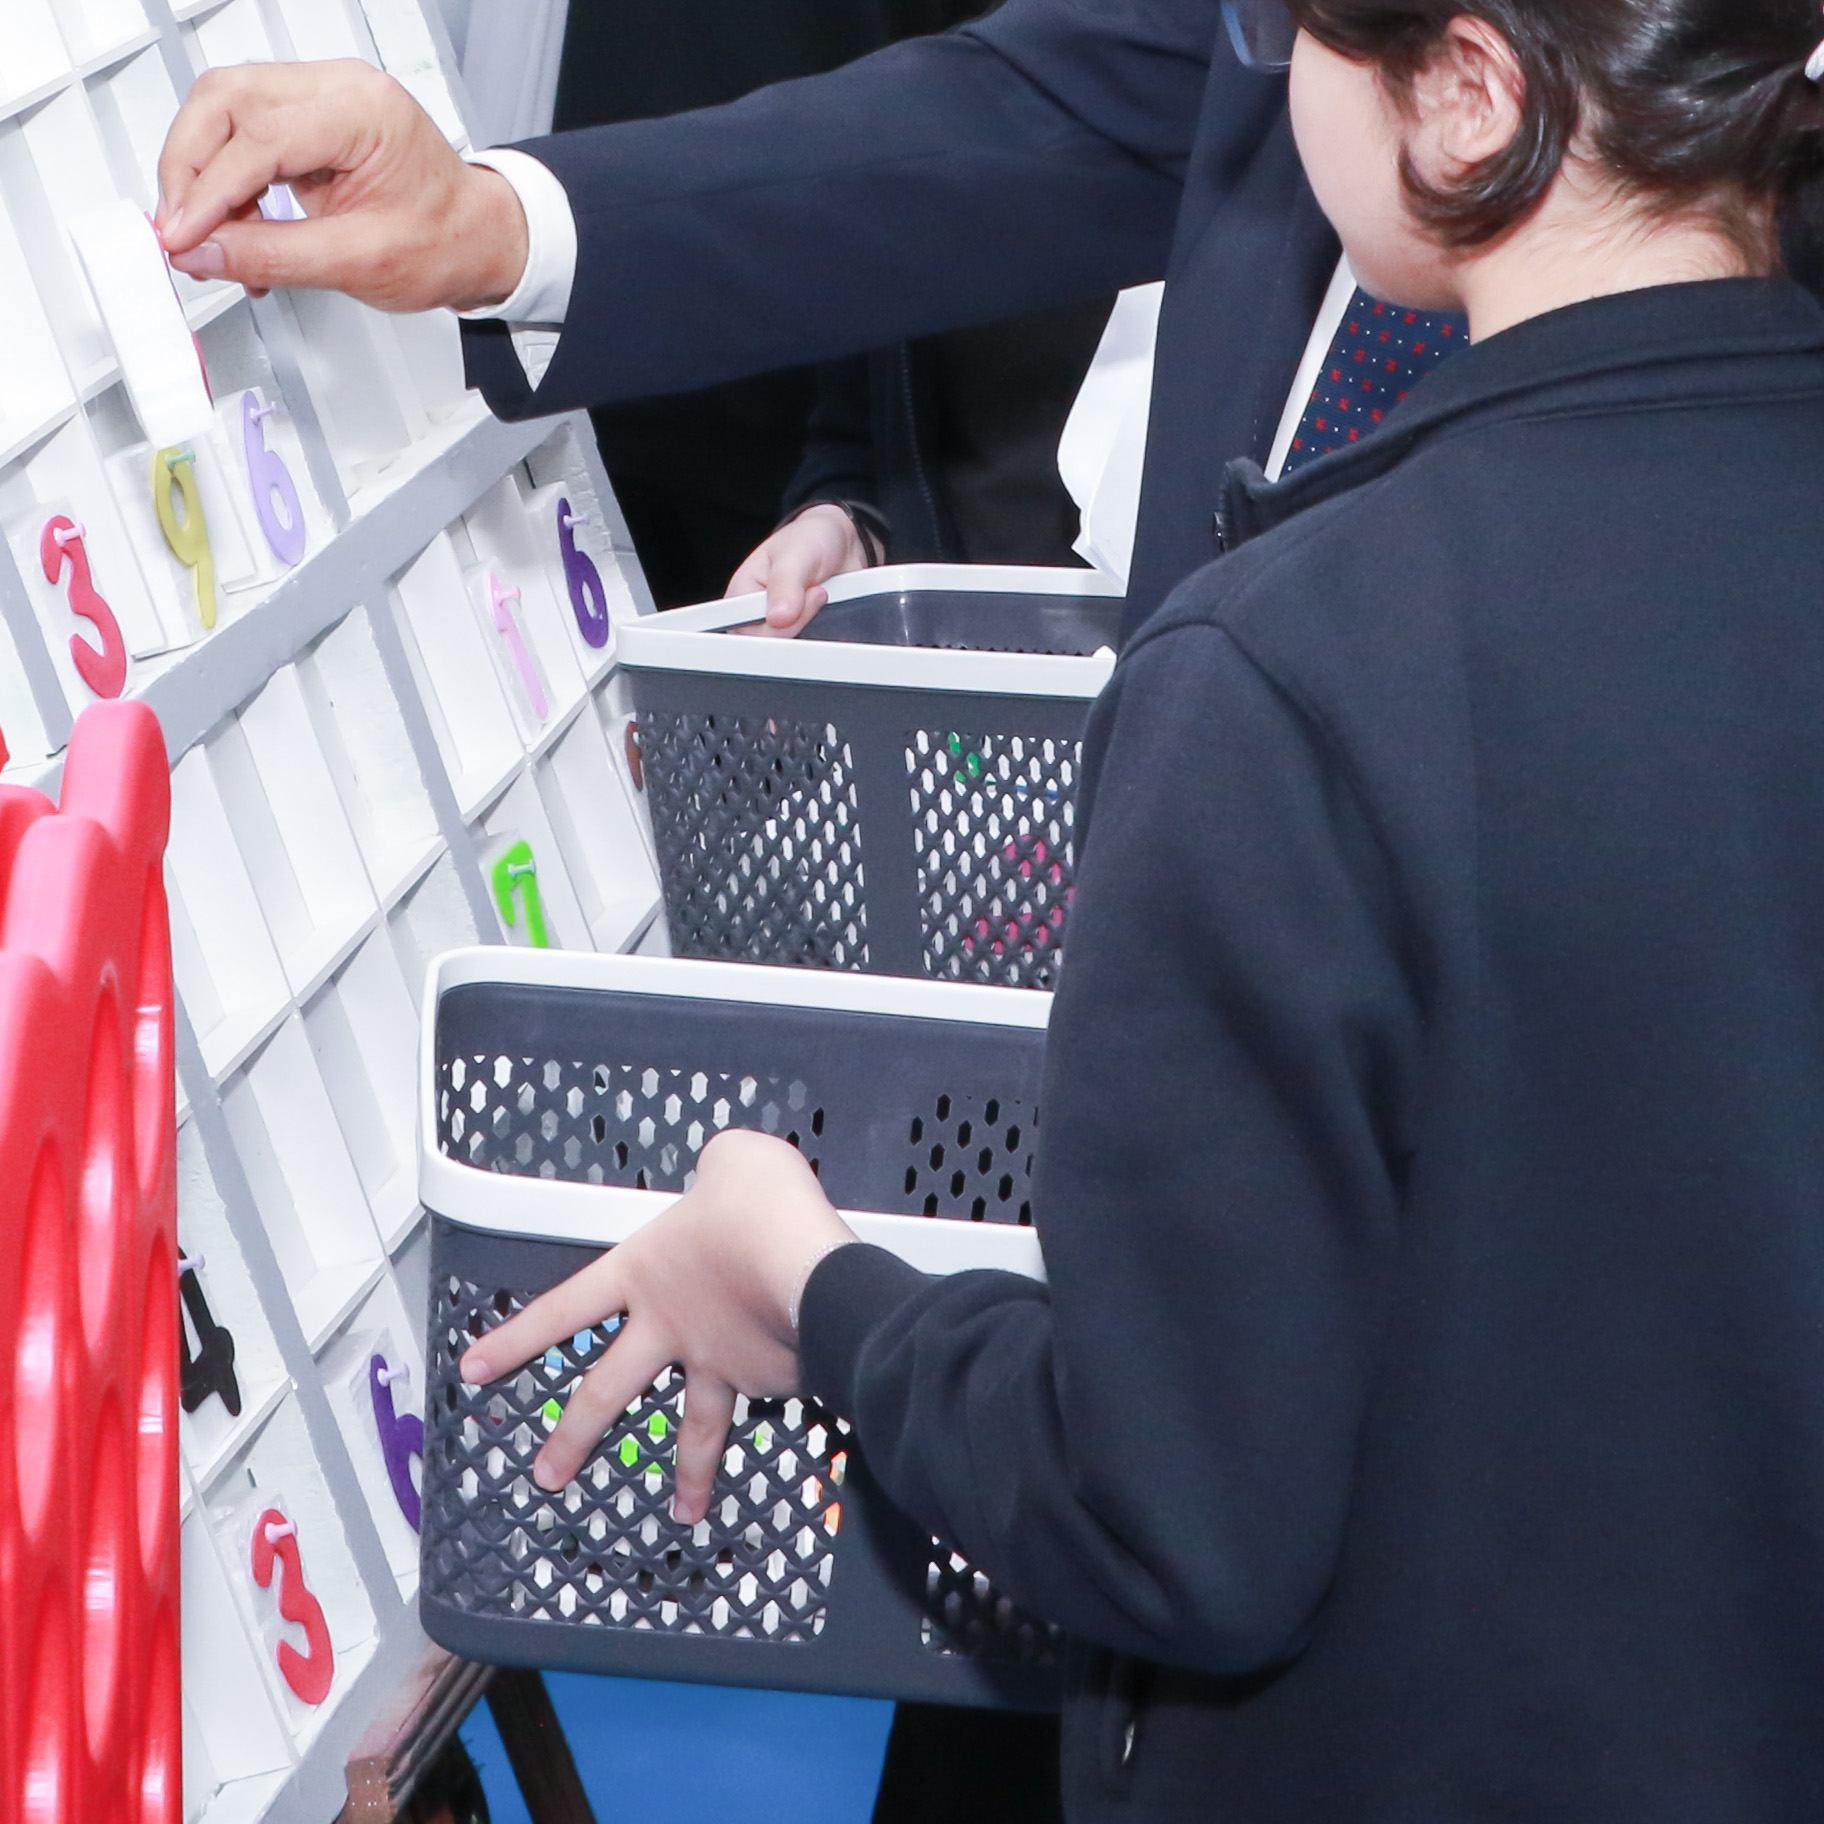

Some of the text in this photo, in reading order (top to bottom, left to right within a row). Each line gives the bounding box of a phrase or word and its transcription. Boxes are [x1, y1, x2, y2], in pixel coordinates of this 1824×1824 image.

[40, 514, 128, 699] 3
[155, 447, 217, 630] 9
[238, 387, 307, 568] 6
[483, 497, 610, 722] 1 6
[250, 1508, 335, 1705] 3
